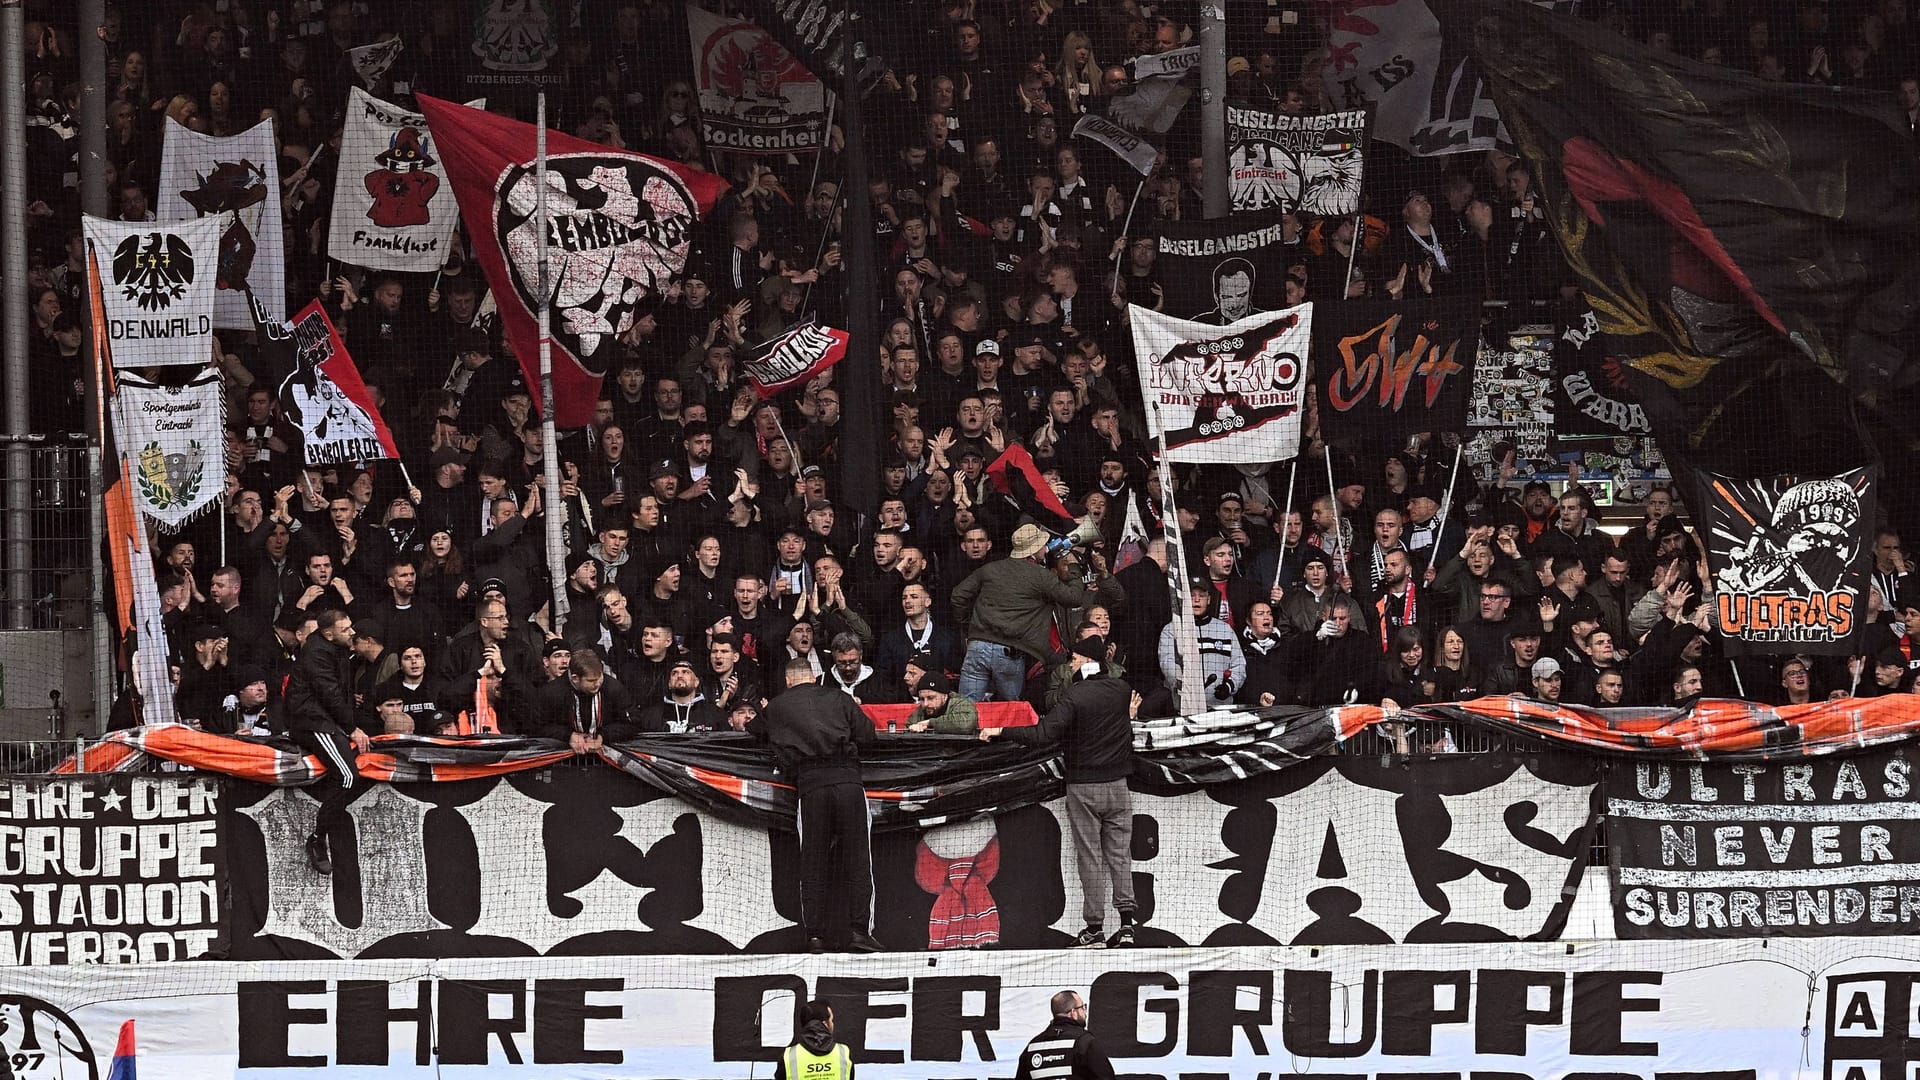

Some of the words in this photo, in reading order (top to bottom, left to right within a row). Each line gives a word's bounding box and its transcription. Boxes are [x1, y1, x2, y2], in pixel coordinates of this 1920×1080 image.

[1227, 106, 1366, 131] GEISELGANGSTER
[1234, 168, 1288, 181] Eintracht
[1717, 591, 1854, 636] ULTRAS
[131, 776, 219, 820] DER
[1635, 759, 1911, 802] ULTRAS
[0, 819, 218, 878] GRUPPE
[1659, 825, 1894, 867] NEVER
[0, 879, 219, 927] STADION
[1625, 886, 1920, 929] SURRENDER
[237, 977, 625, 1068] EHRE
[713, 975, 1001, 1064] DER
[1089, 969, 1663, 1058] GRUPPE
[806, 1062, 833, 1074] SDS
